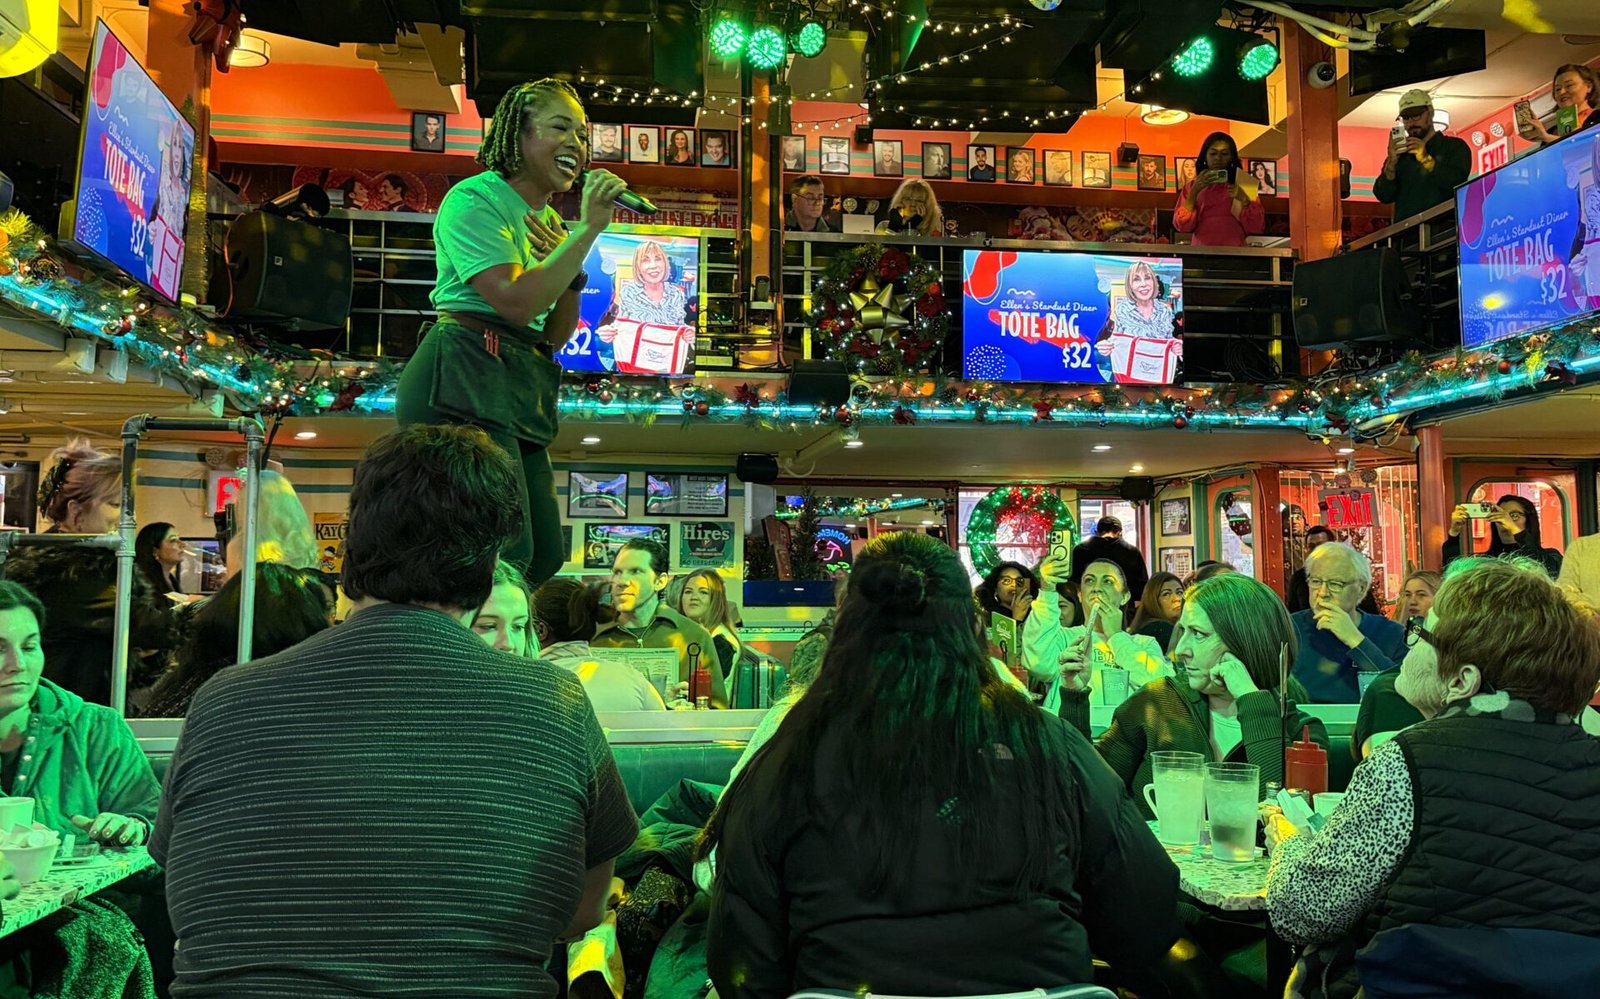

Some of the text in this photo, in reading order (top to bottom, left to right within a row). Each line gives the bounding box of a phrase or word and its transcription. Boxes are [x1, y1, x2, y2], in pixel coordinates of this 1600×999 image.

[104, 137, 146, 210] TOTE BAG
[1481, 143, 1505, 173] EXIT
[130, 214, 147, 258] $32
[1486, 211, 1569, 248] Ellen's Stardust Diner
[1486, 228, 1554, 282] TOTE BAG
[1540, 263, 1568, 305] $32
[1000, 300, 1098, 312] Ellen's Stardust Diner
[999, 311, 1080, 339] TOTE BAG
[1062, 342, 1092, 369] $32
[1325, 493, 1373, 527] EXIT
[683, 524, 730, 540] Hires
